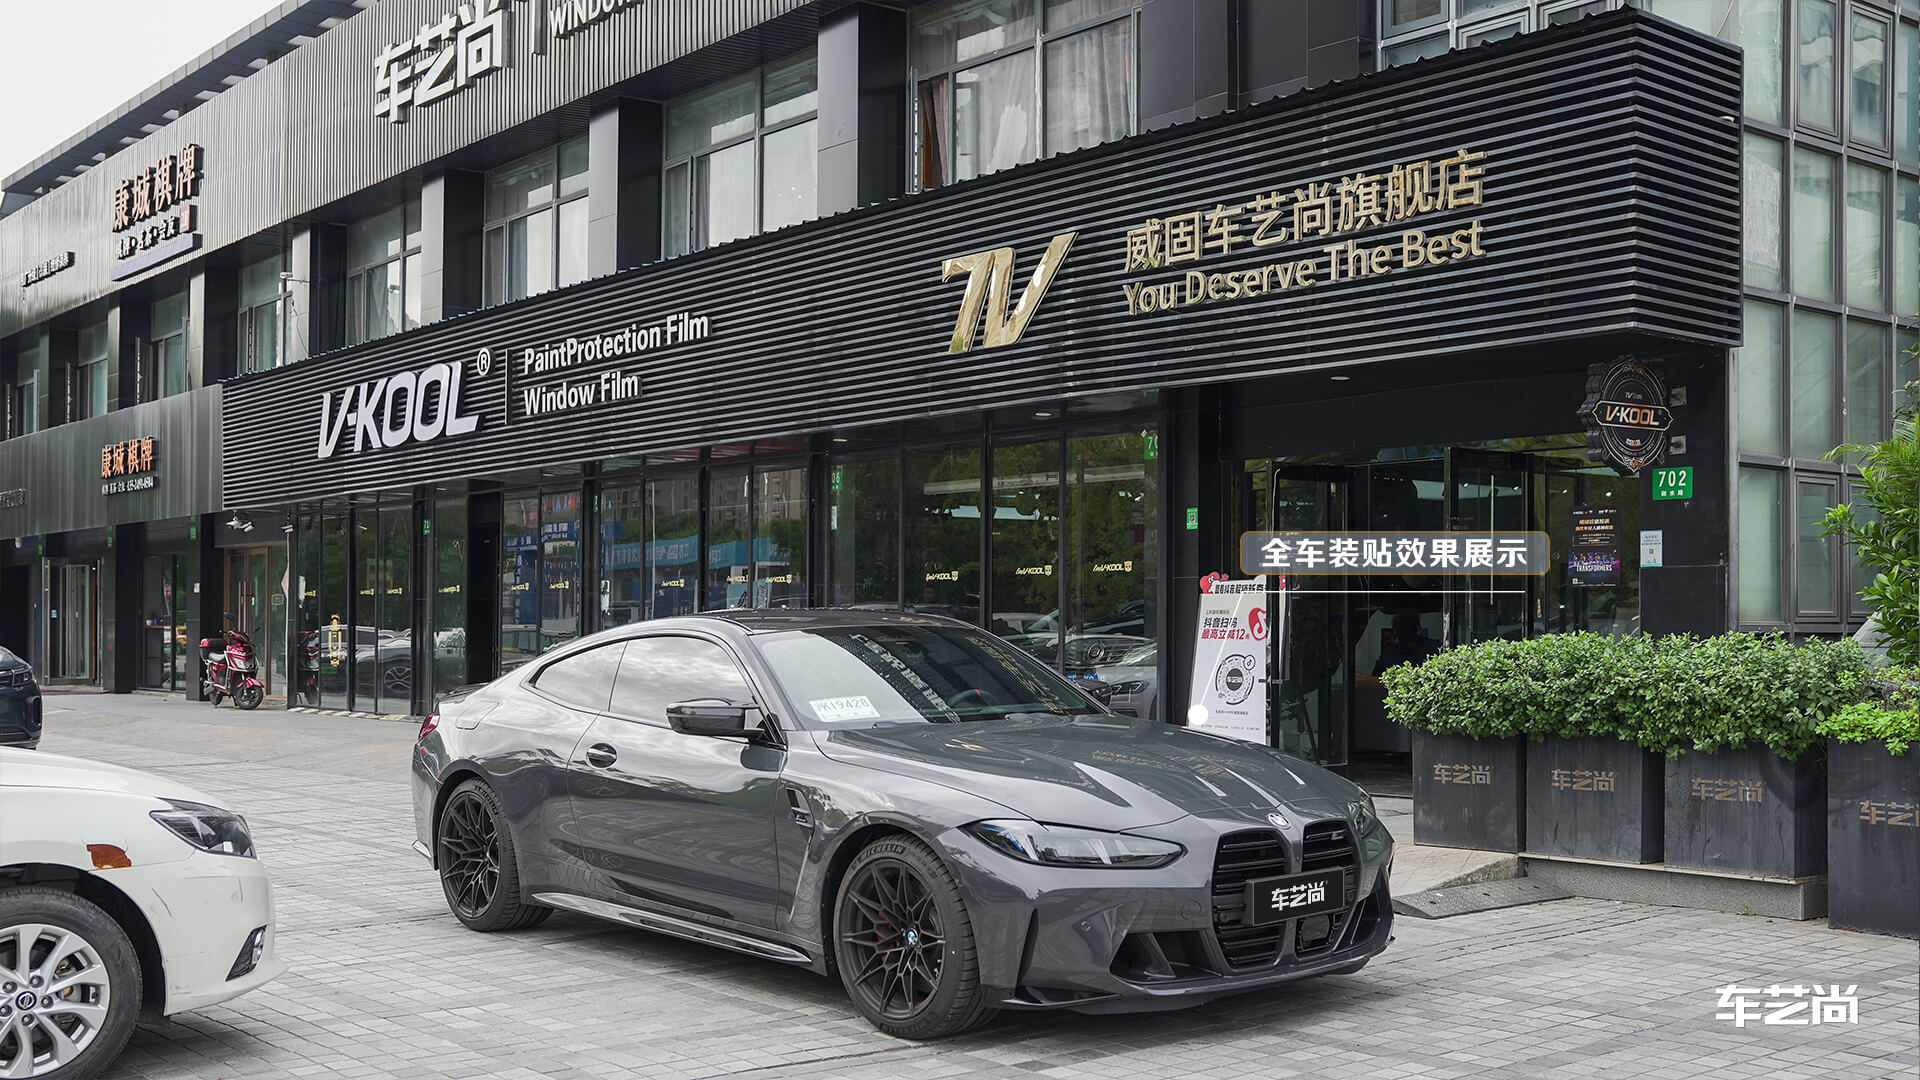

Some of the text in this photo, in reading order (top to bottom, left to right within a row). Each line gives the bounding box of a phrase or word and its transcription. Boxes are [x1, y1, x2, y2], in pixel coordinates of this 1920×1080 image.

[374, 0, 506, 124] 车艺尚
[112, 143, 196, 232] 康城棋牌
[1124, 149, 1488, 273] 威固车艺尚旗舰店
[1123, 220, 1486, 315] You Deserve The Best
[524, 312, 709, 375] PaintProtection Film
[317, 361, 479, 459] V-KOOL
[524, 371, 639, 416] Window Film
[102, 435, 153, 479] 康城棋牌
[1658, 470, 1687, 488] 702
[1433, 763, 1491, 784] 车艺尚
[1551, 768, 1615, 792] 车艺尚
[1691, 777, 1763, 803] 车艺尚
[1859, 799, 1920, 828] 车艺
[1271, 880, 1325, 911] 车艺尚
